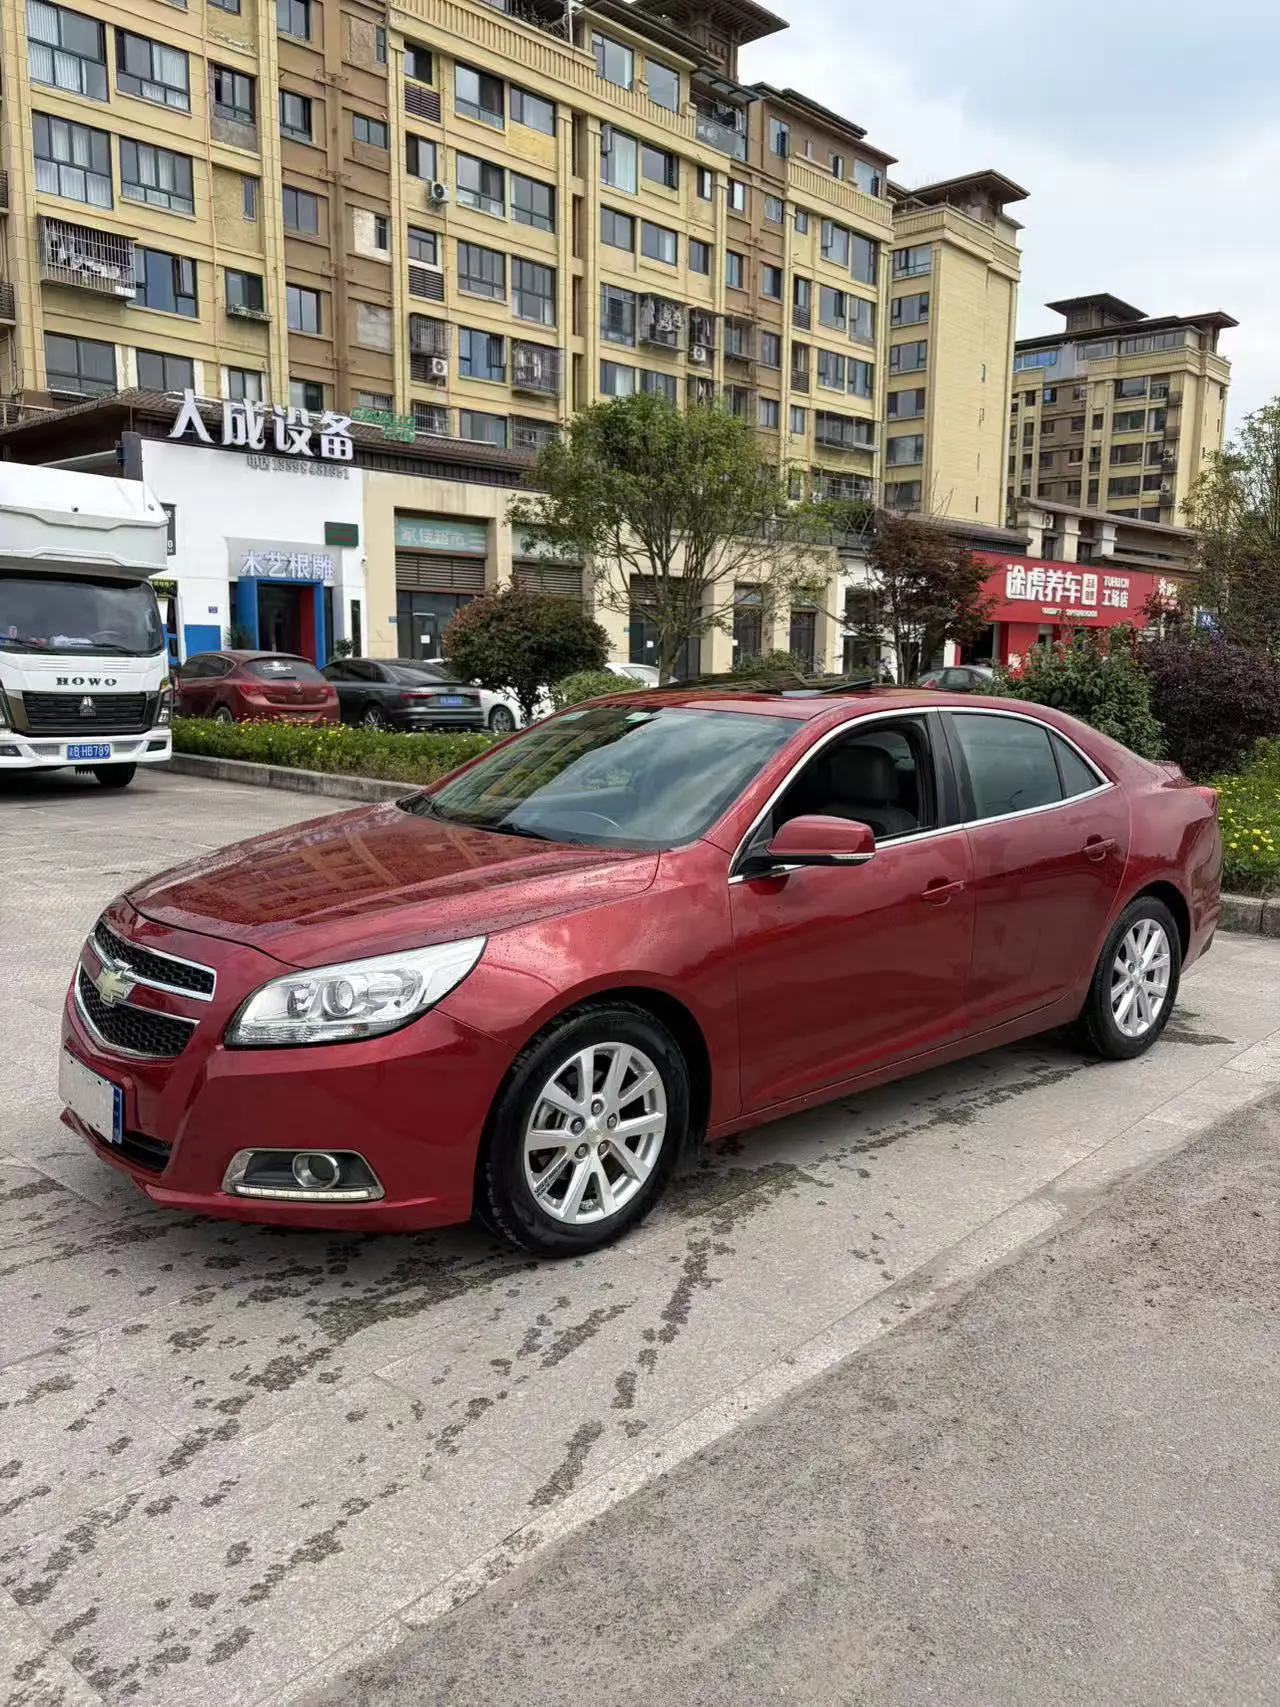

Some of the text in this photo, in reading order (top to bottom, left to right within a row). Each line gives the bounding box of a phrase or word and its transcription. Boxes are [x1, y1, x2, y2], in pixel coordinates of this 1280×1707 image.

[240, 549, 334, 580] 木艺根雕
[1006, 564, 1081, 604] 途虎养车
[56, 677, 117, 686] HOWO
